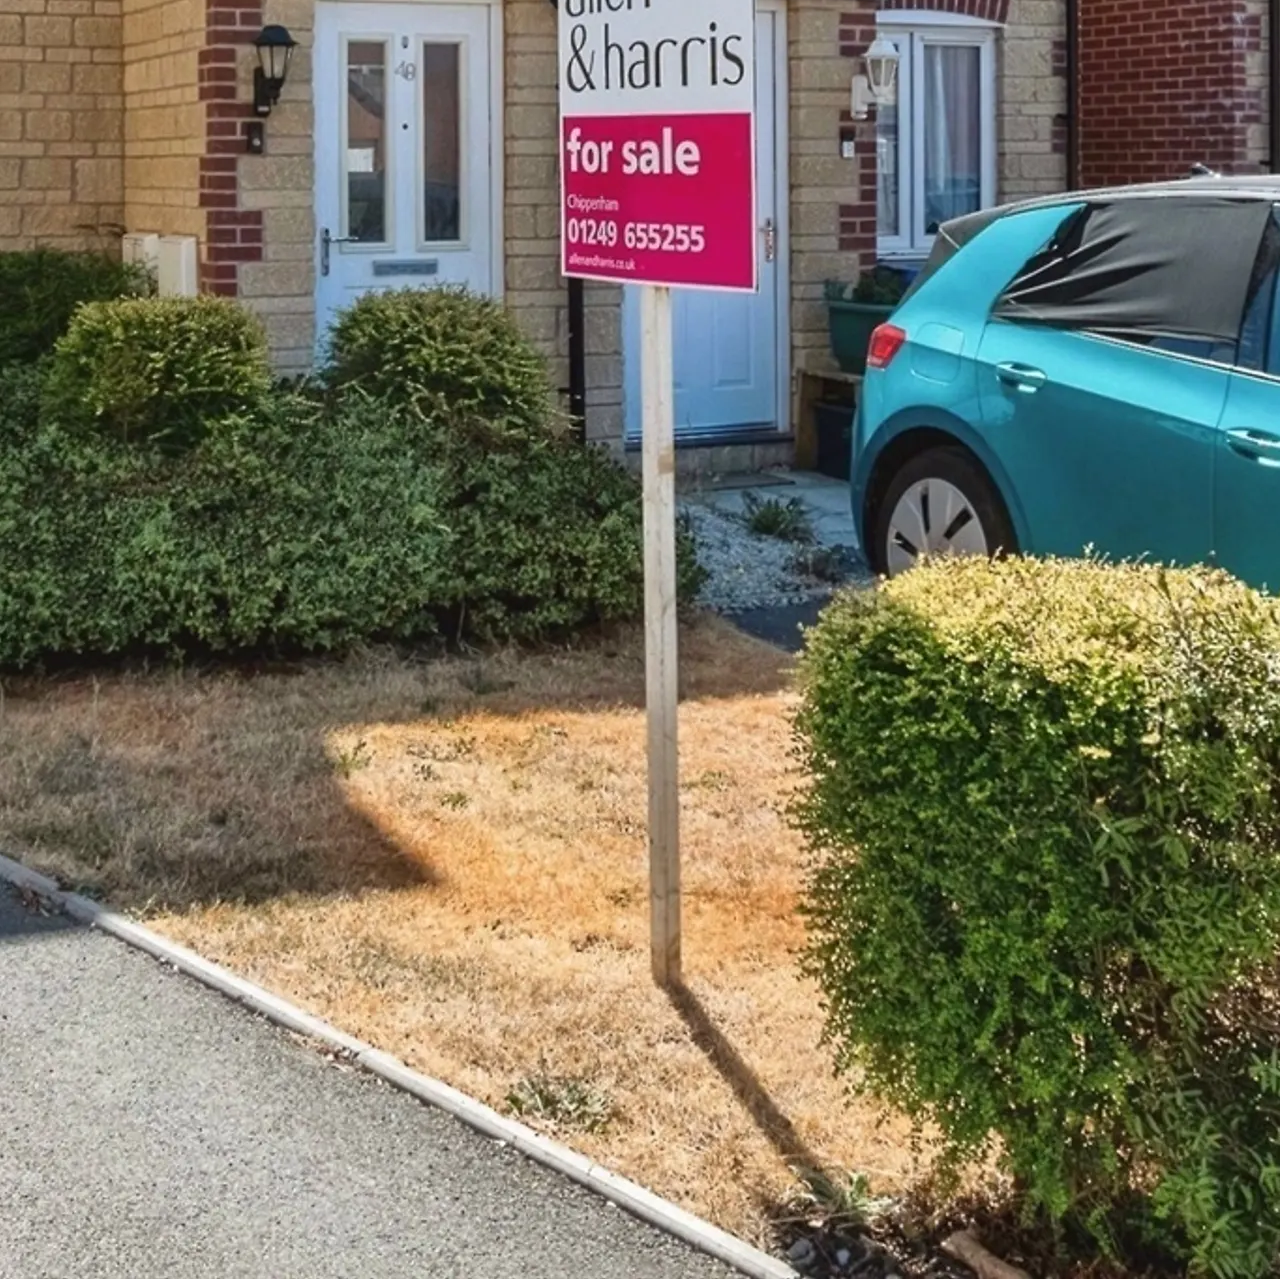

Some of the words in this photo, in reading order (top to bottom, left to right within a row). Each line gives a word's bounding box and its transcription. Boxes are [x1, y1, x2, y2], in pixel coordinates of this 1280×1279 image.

[394, 60, 416, 81] 48
[566, 127, 613, 173] for
[622, 126, 701, 175] sale
[567, 193, 619, 213] Chippenham
[567, 218, 618, 247] 01249
[624, 221, 705, 252] 655255
[569, 252, 636, 270] allenandharris.co.uk
